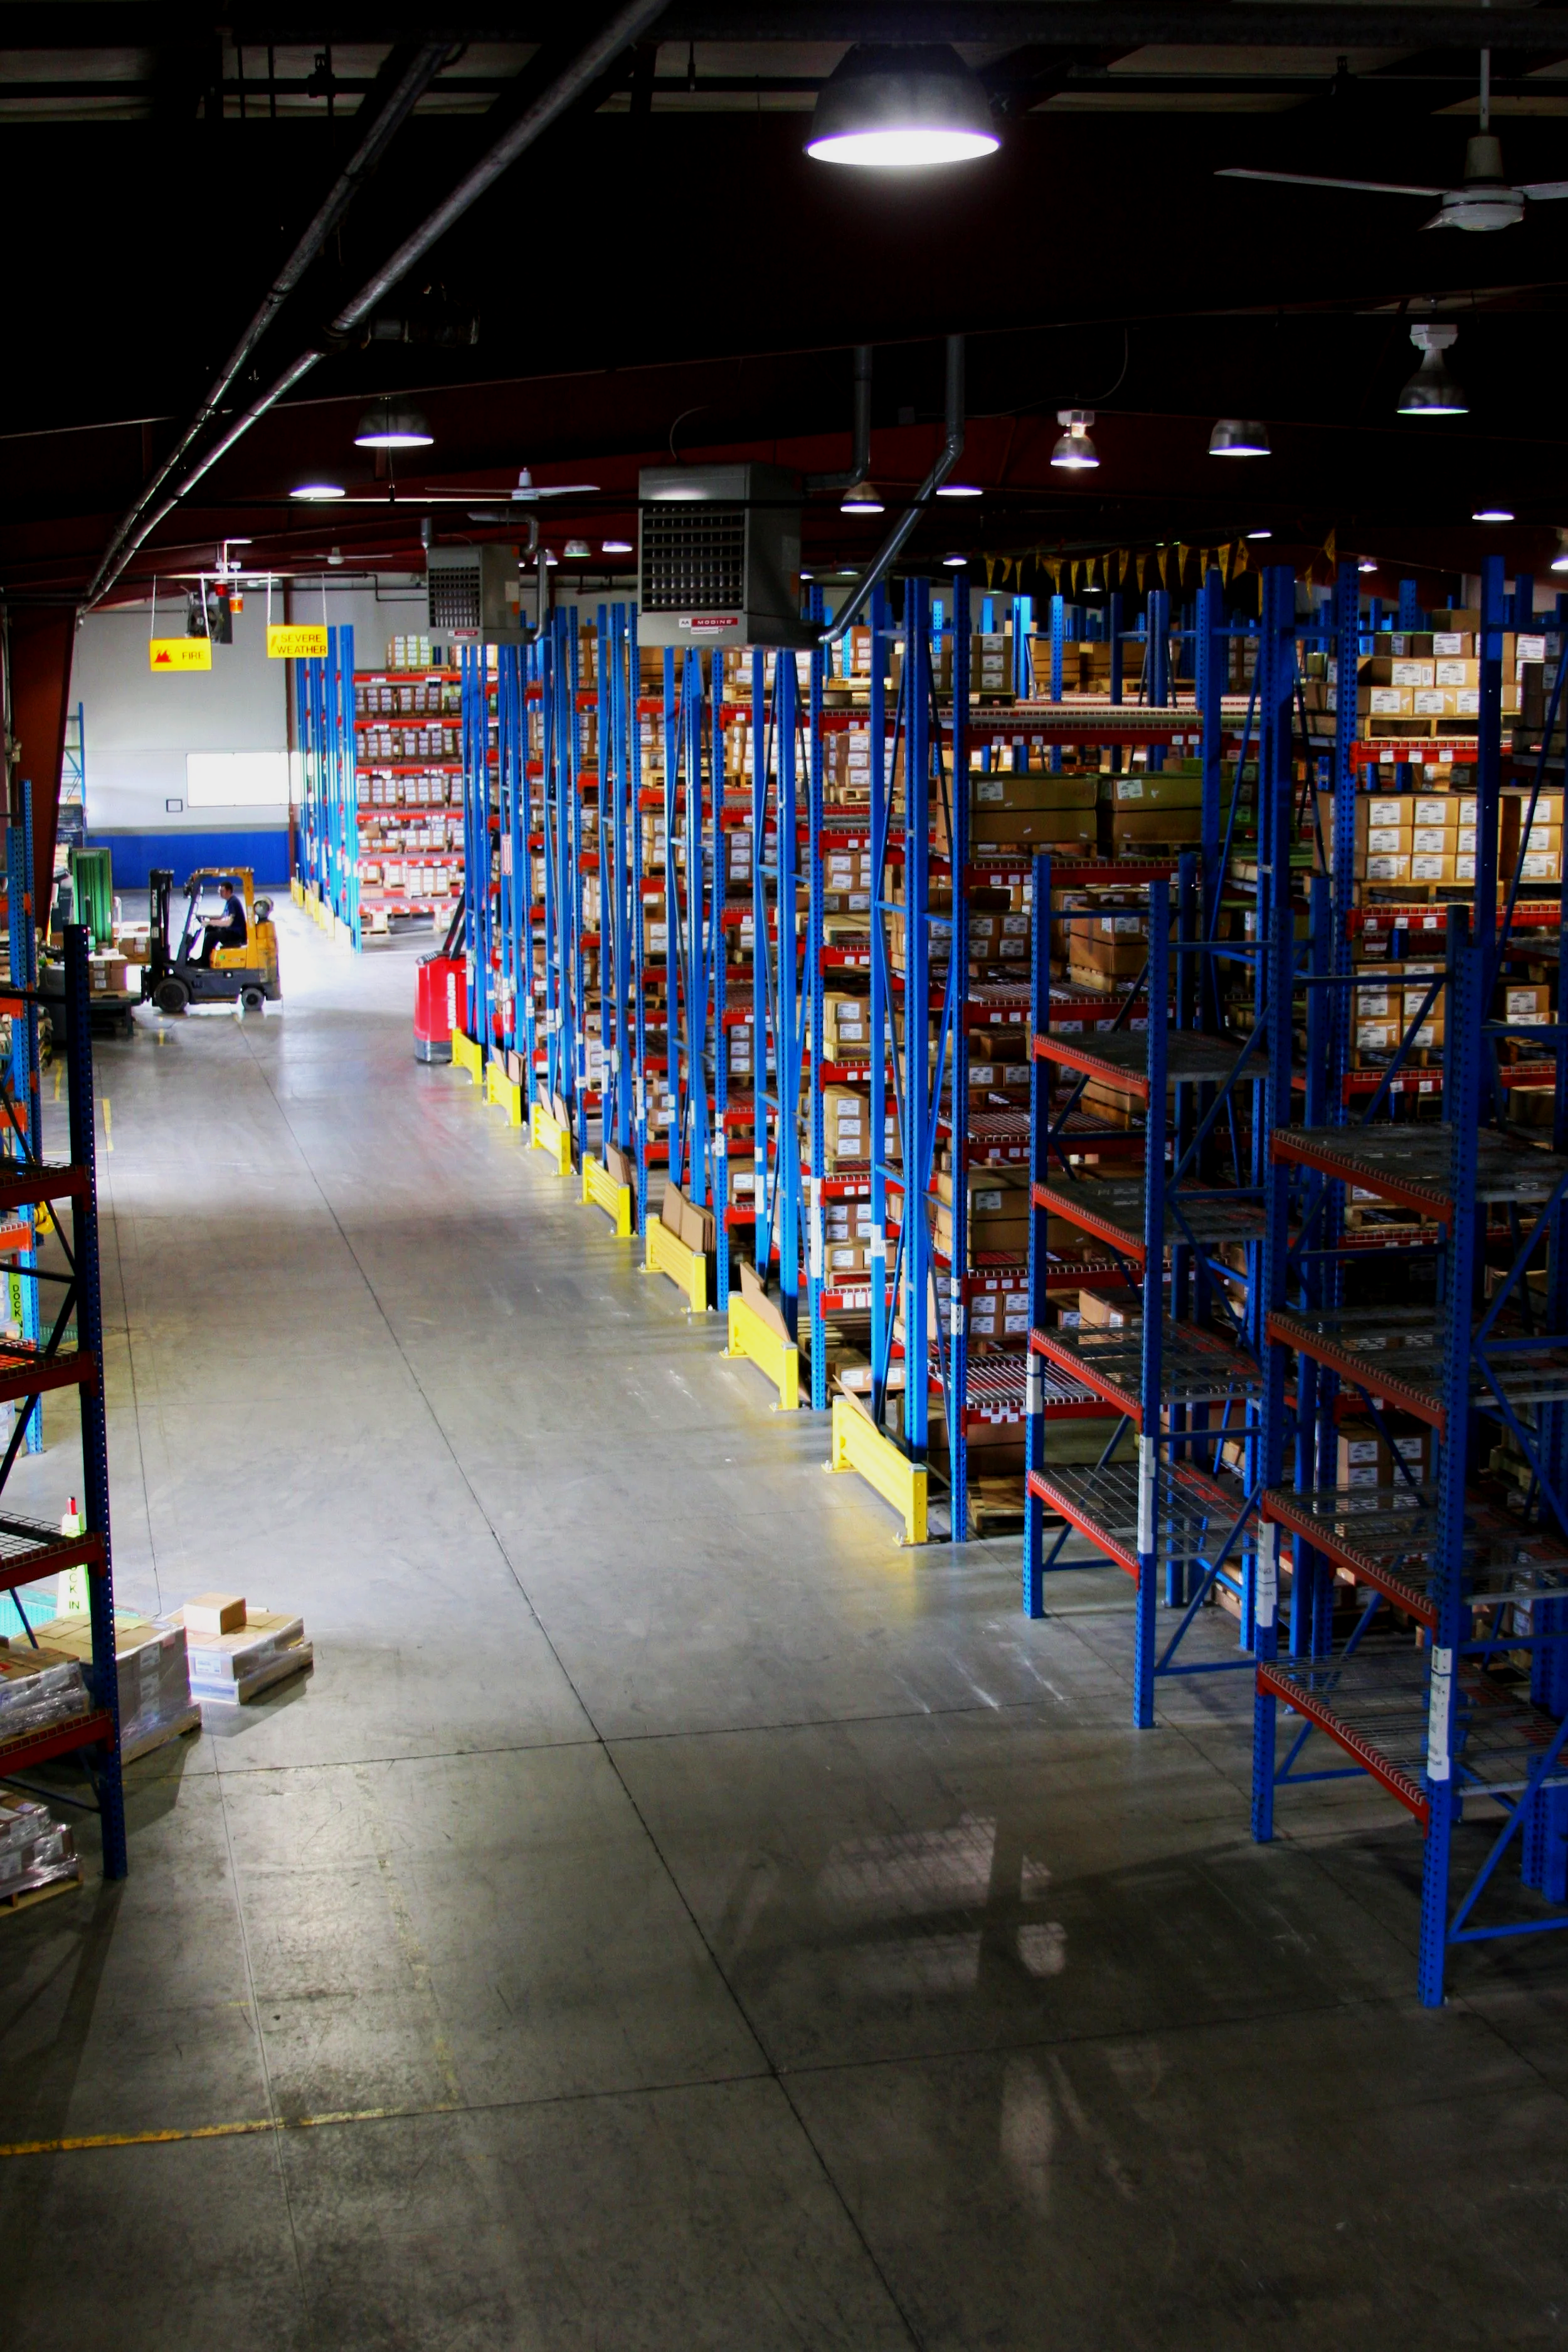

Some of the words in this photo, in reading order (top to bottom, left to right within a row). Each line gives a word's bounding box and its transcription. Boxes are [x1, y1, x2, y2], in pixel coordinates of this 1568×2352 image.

[281, 634, 322, 643] SEVERE
[277, 645, 327, 654] WEATHER
[182, 652, 204, 660] FIRE
[447, 972, 457, 1029] RAYMOND
[13, 1285, 21, 1317] DOCK
[69, 1601, 80, 1610] IN
